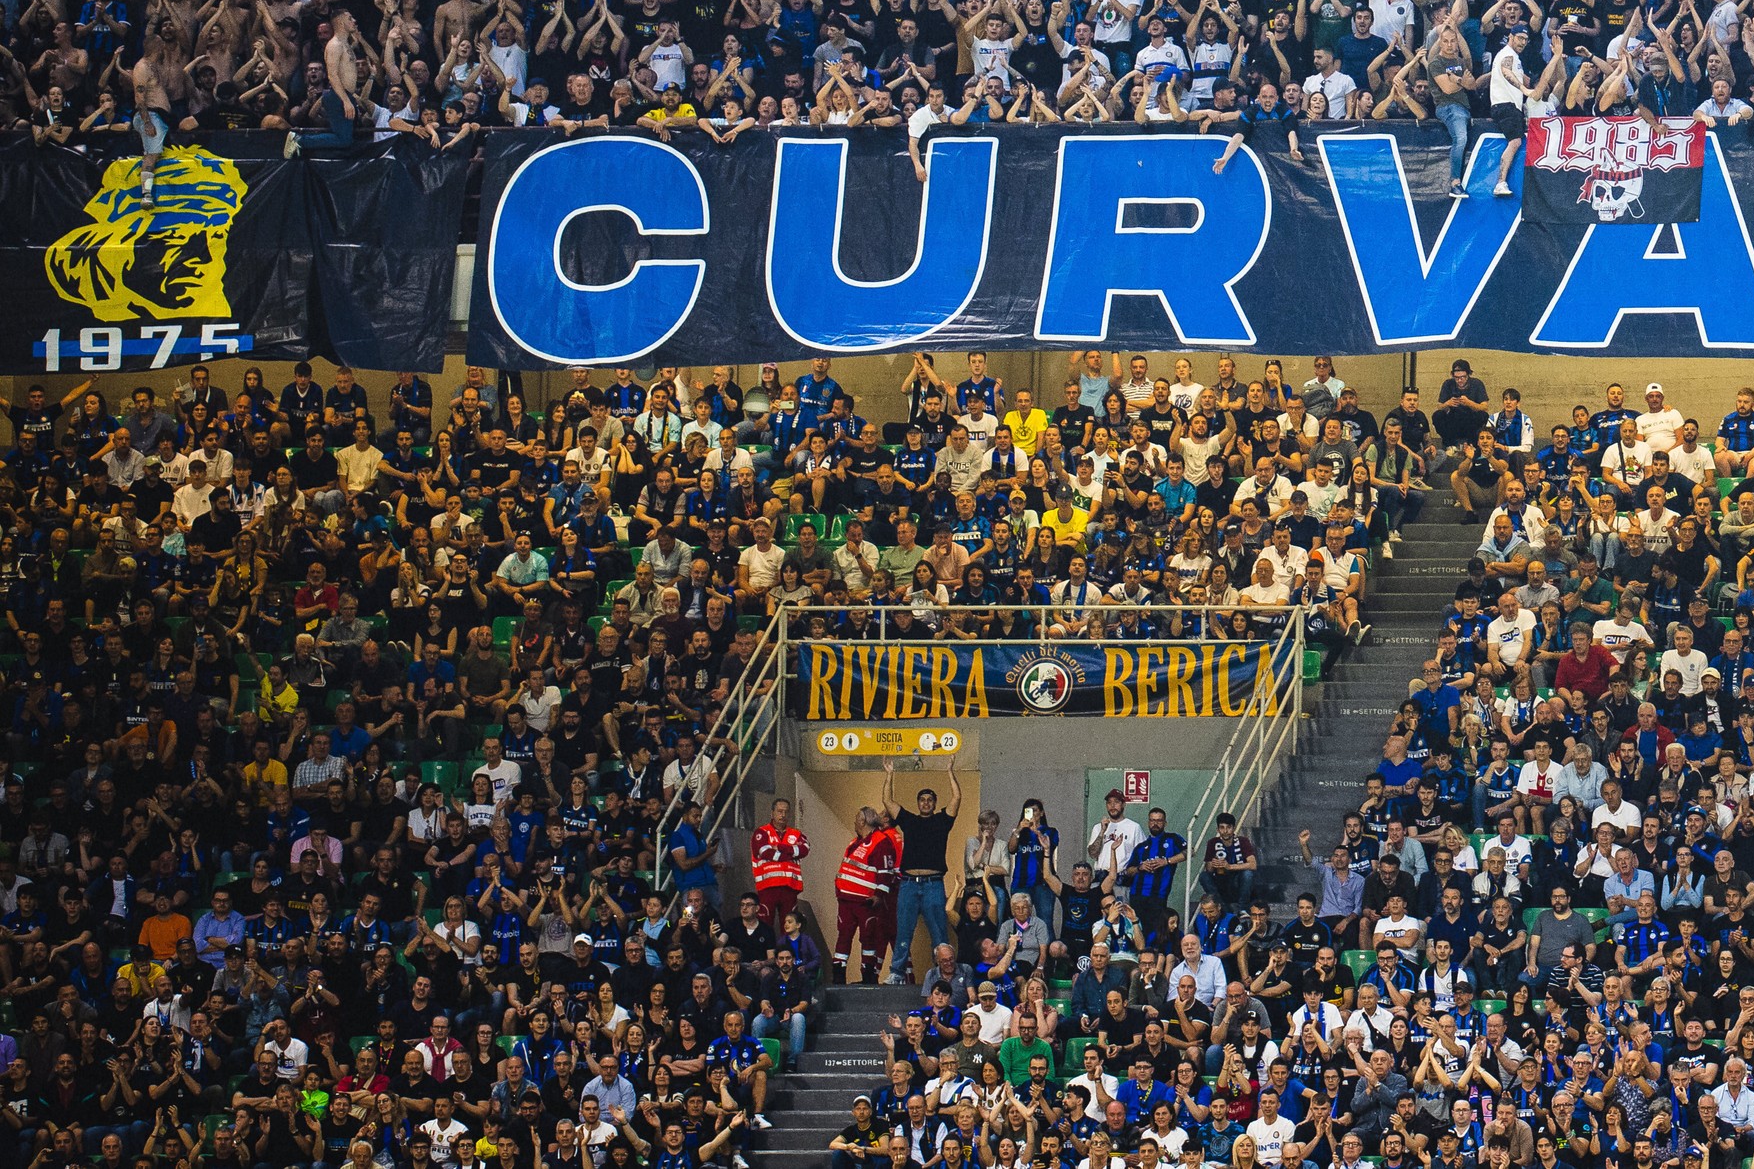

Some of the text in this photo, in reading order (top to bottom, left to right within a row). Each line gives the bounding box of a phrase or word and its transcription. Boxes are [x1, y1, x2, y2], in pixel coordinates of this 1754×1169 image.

[1533, 117, 1696, 172] 1985
[43, 323, 242, 373] 1975
[806, 645, 990, 720] RIVIERA
[1103, 643, 1279, 719] BERICA
[823, 736, 835, 748] 23
[875, 732, 904, 744] USCITA
[942, 736, 956, 748] 23
